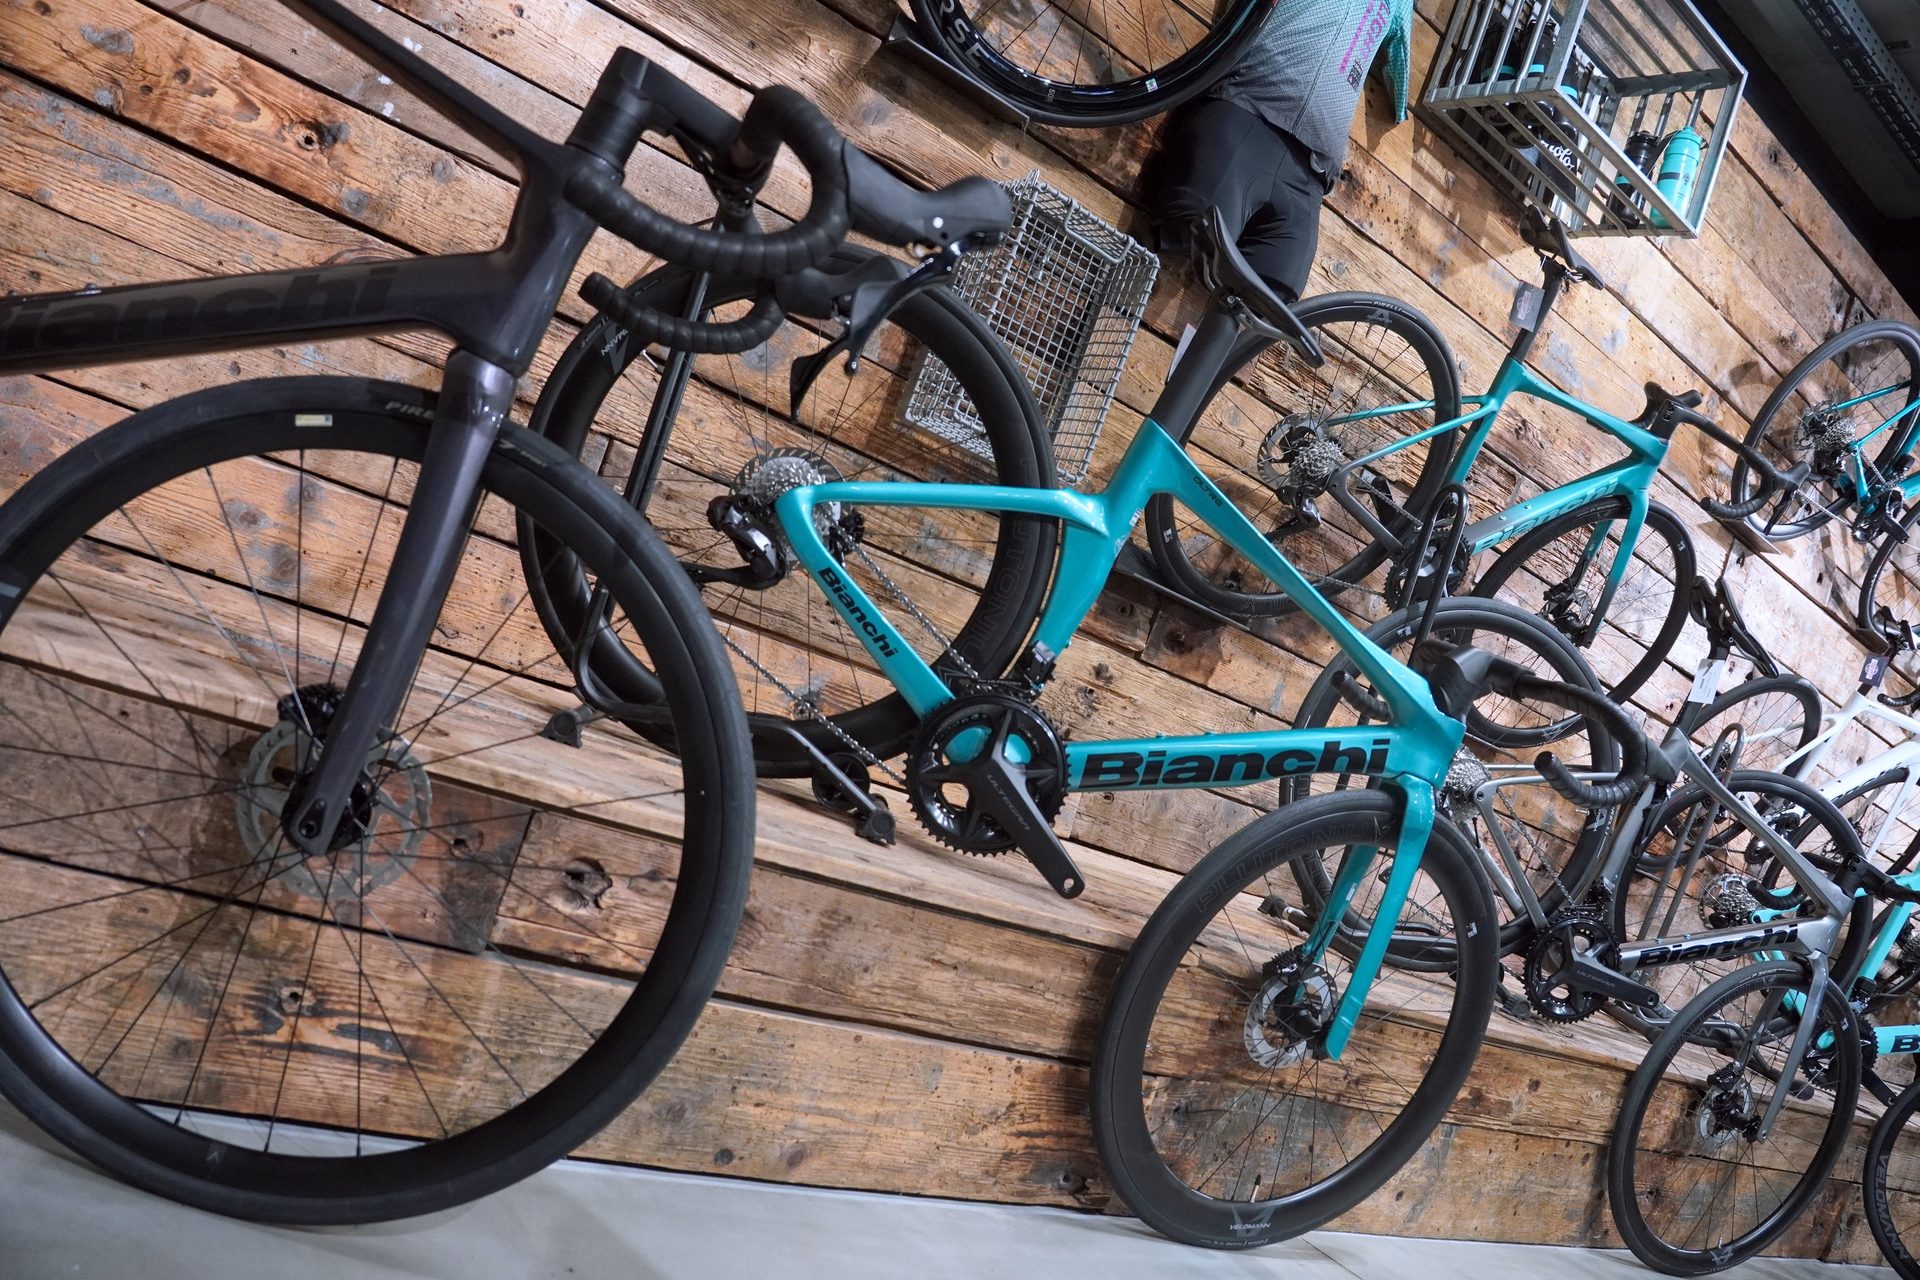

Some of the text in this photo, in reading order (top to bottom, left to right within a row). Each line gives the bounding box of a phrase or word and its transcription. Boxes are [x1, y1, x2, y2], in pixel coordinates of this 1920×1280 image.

[0, 266, 399, 357] ianchi
[1372, 300, 1402, 312] PIRELLI
[817, 566, 899, 658] Bianchi
[1079, 738, 1391, 789] Bianchi
[1637, 923, 1799, 967] Bianchi
[1229, 1222, 1272, 1232] VELOMANN
